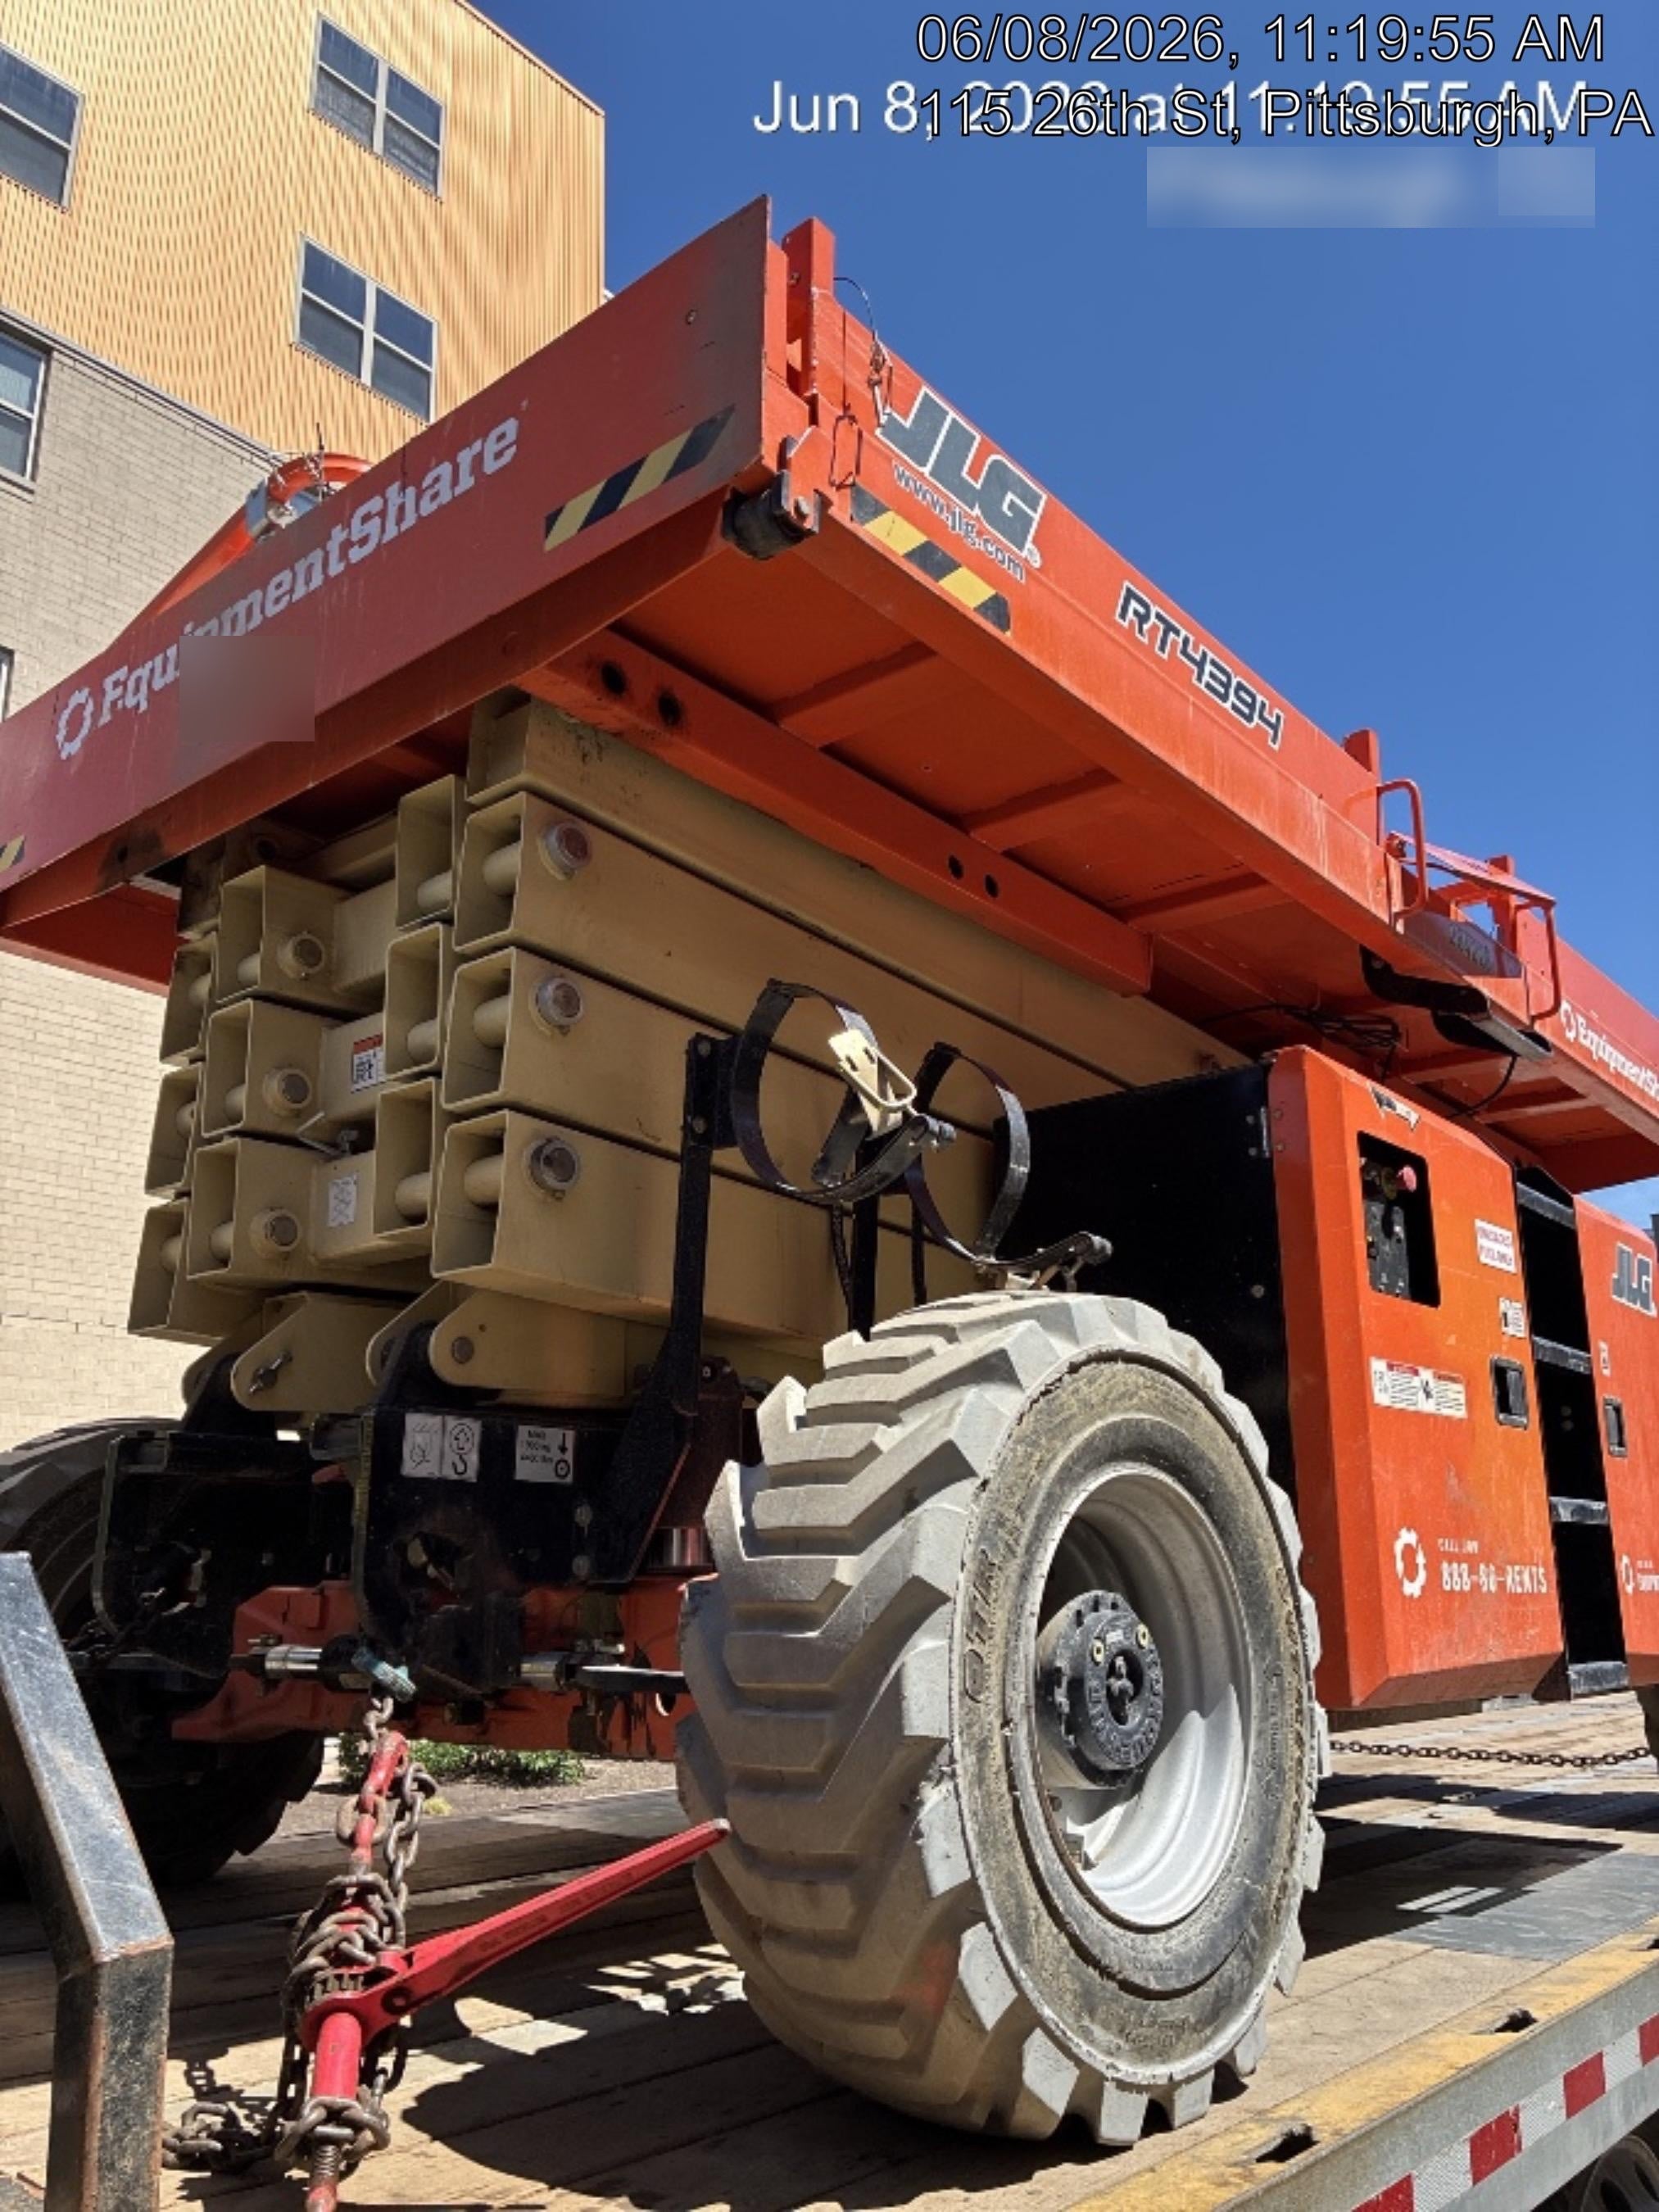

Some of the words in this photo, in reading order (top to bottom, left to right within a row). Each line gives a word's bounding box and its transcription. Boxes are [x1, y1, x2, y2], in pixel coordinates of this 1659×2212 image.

[875, 383, 1048, 559] JLG
[892, 460, 1026, 583] www.jlg.com
[1115, 579, 1285, 752] RT4394
